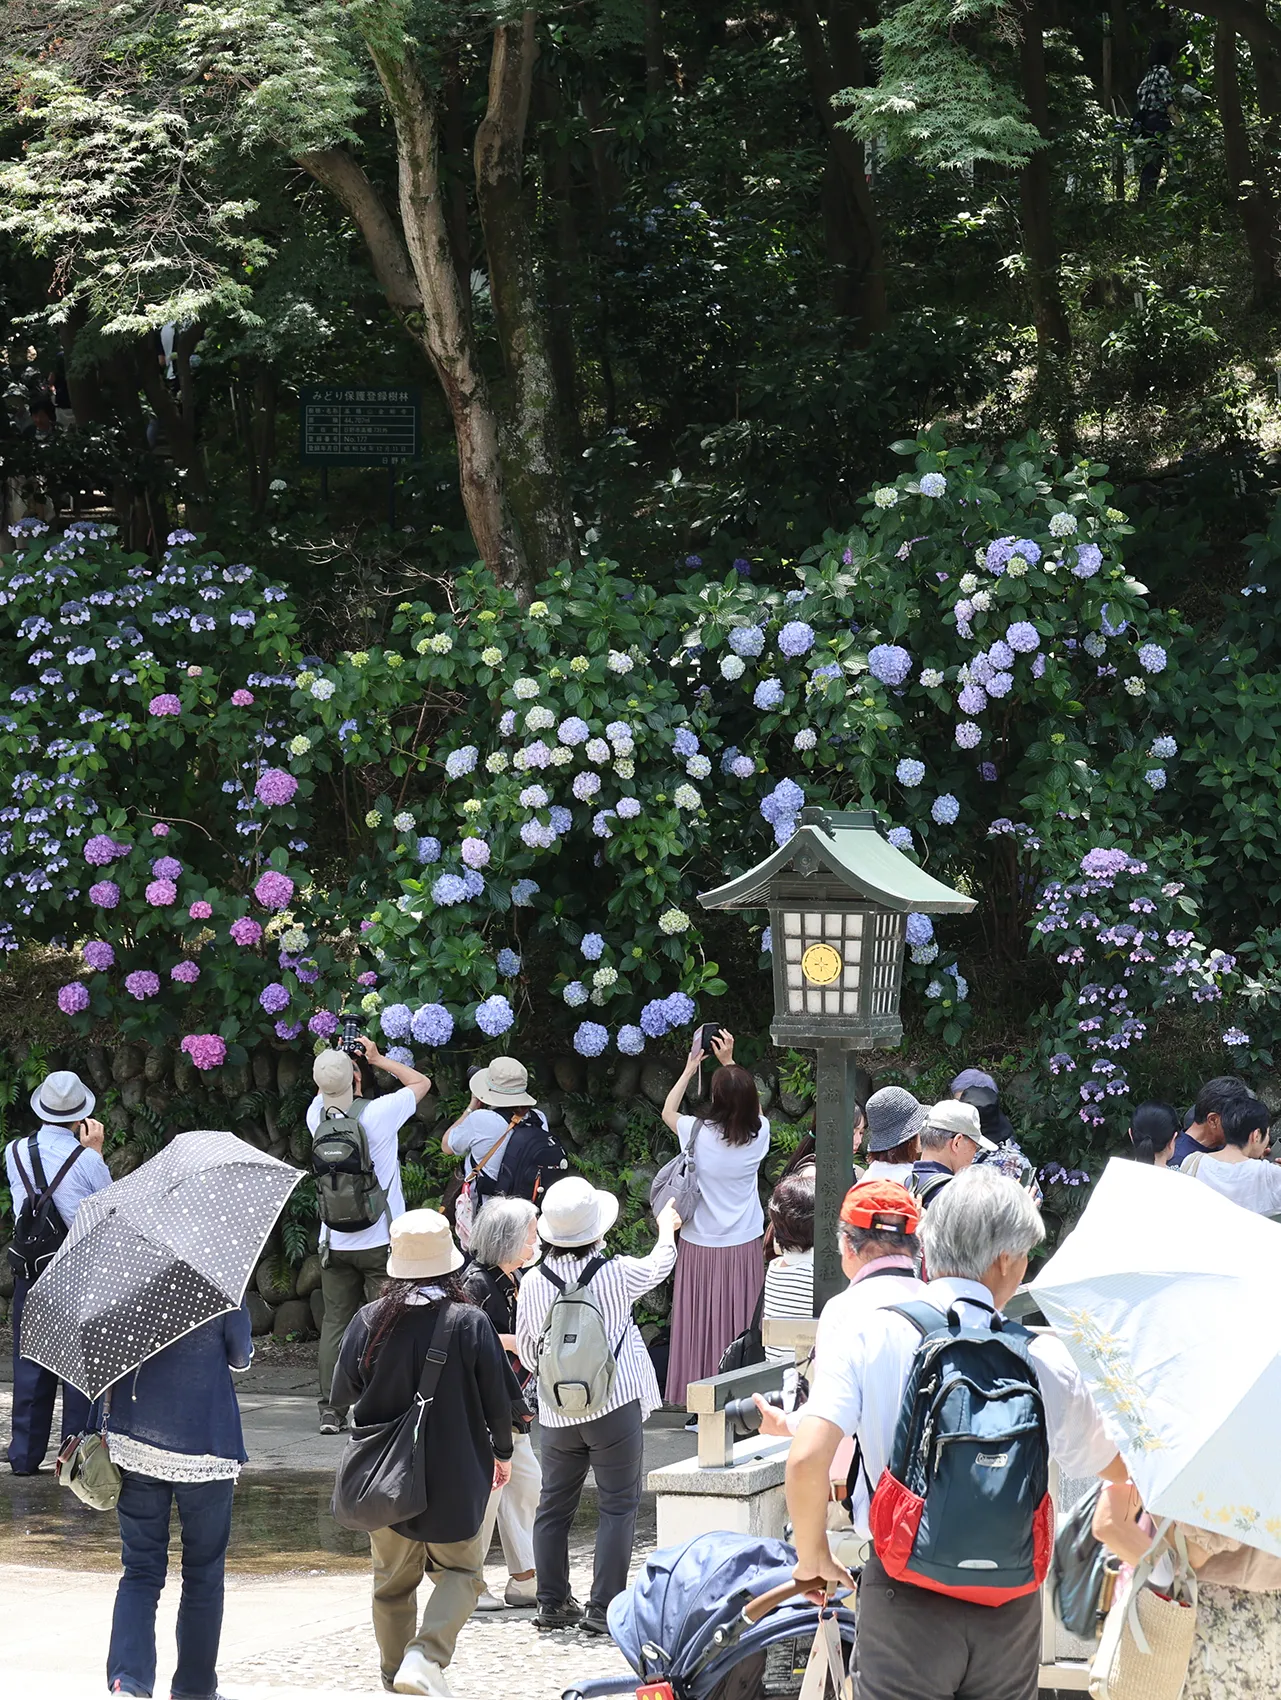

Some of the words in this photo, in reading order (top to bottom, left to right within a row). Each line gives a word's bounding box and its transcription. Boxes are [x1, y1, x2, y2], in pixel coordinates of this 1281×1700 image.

[312, 390, 409, 402] みどり保護登録樹林
